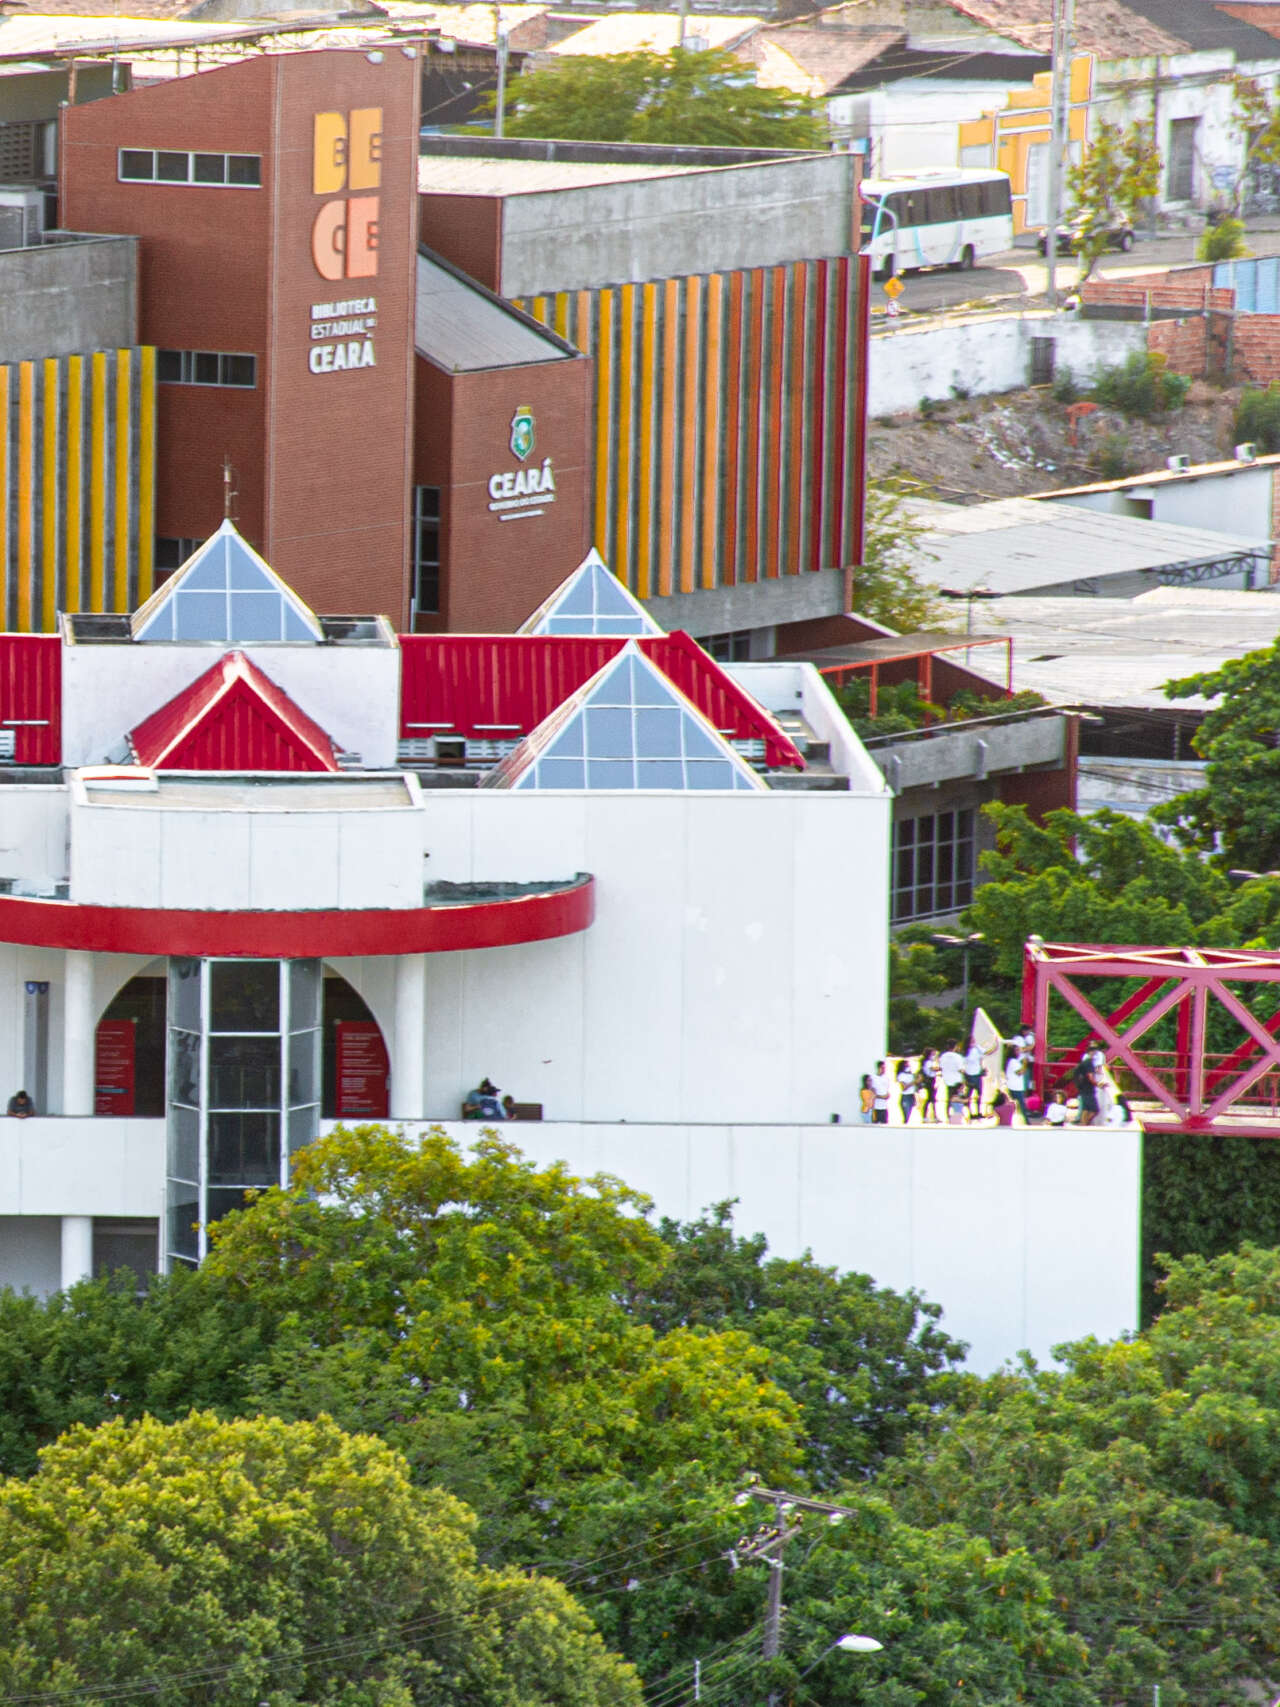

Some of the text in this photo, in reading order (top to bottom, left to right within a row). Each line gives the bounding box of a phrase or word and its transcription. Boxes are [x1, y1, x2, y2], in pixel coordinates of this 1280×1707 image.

[311, 297, 377, 320] BIBLIOTECA
[311, 321, 368, 339] ESTADUAL
[309, 333, 376, 373] CEARÁ
[489, 457, 555, 499] CEARÁ
